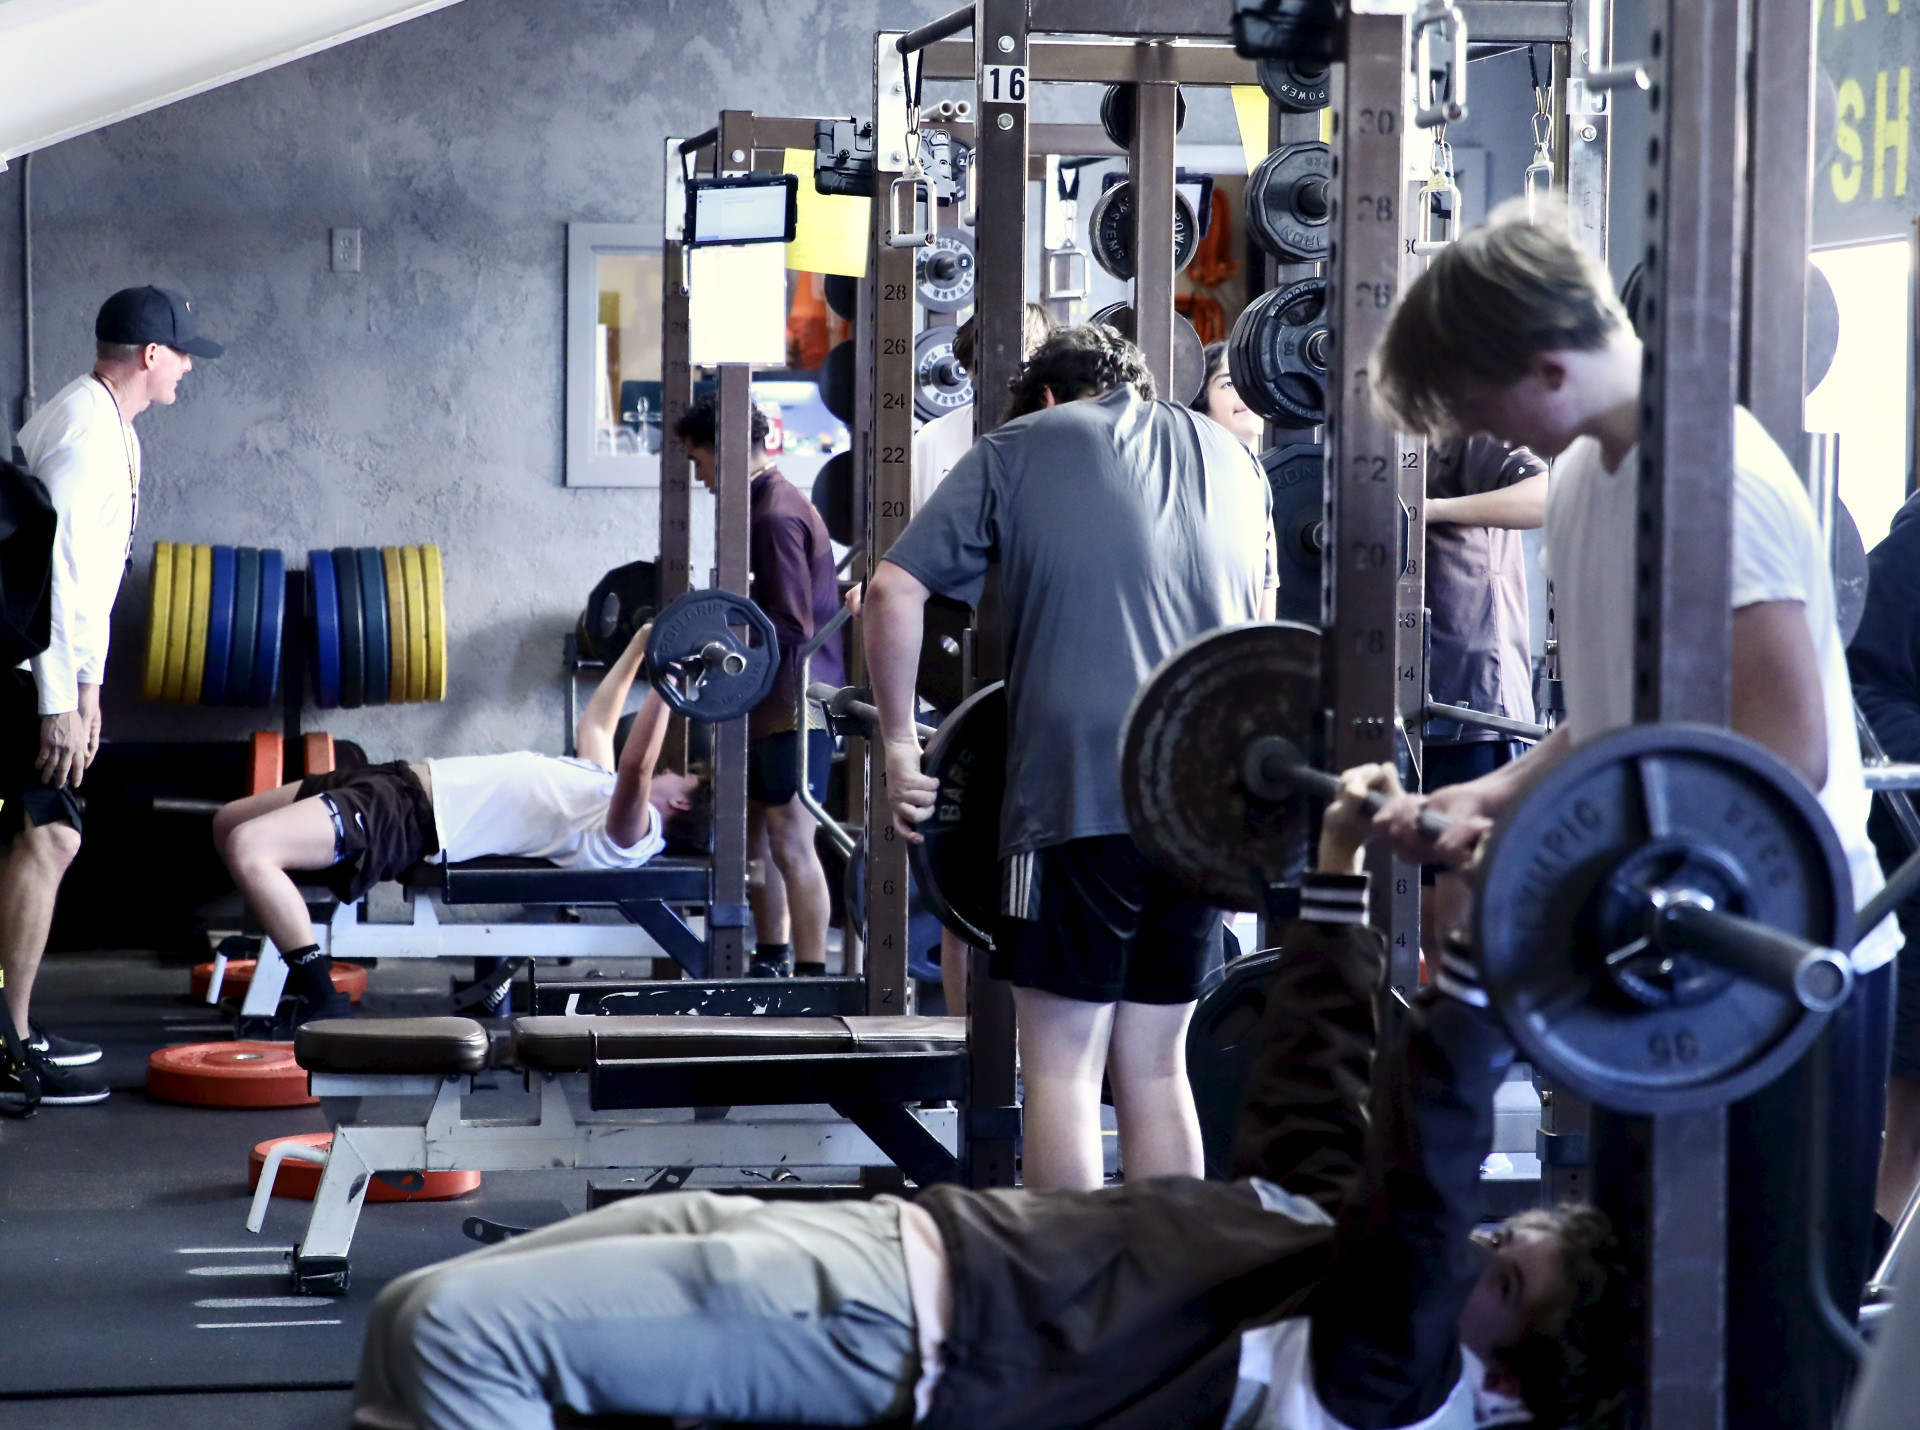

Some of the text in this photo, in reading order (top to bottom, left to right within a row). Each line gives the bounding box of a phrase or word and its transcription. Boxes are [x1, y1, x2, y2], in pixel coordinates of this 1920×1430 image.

[989, 67, 1026, 100] 16
[1281, 83, 1325, 101] POWER
[884, 284, 907, 301] 28
[883, 338, 906, 355] 26
[882, 392, 905, 410] 24
[881, 447, 905, 463] 22
[1270, 462, 1319, 494] RON
[881, 501, 905, 518] 20
[1397, 666, 1415, 682] 14
[884, 826, 895, 842] 8
[883, 879, 895, 896] 6
[1396, 879, 1408, 895] 6
[882, 934, 893, 949] 4
[1395, 932, 1407, 948] 4
[882, 989, 893, 1004] 2
